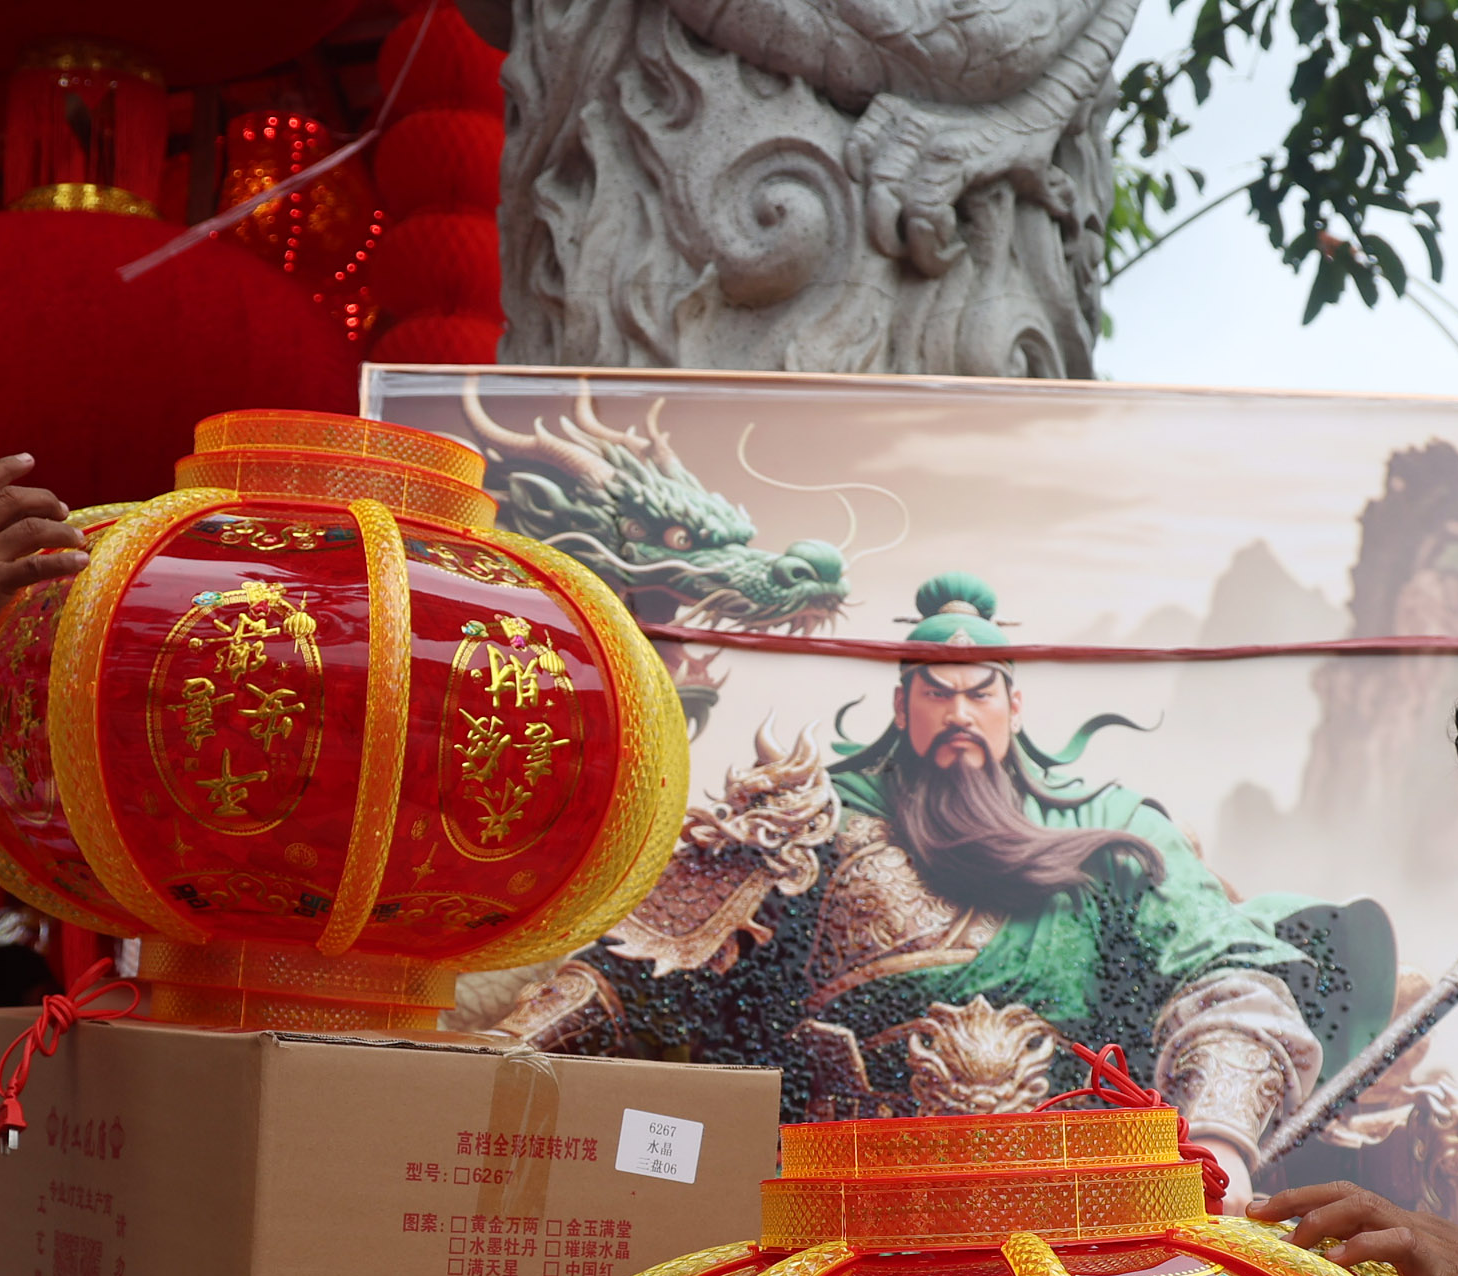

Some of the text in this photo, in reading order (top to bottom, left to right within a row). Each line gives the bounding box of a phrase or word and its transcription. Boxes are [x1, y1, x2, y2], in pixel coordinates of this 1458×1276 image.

[649, 1122, 677, 1137] 6267
[457, 1131, 598, 1161] 高档全彩旋转灯笼
[647, 1140, 672, 1157] 水晶
[473, 1168, 513, 1185] 6267
[470, 1215, 540, 1235] 黄金万两
[566, 1219, 632, 1239] 金玉满堂
[469, 1237, 631, 1260] 水墨牡丹 璀璨水晶
